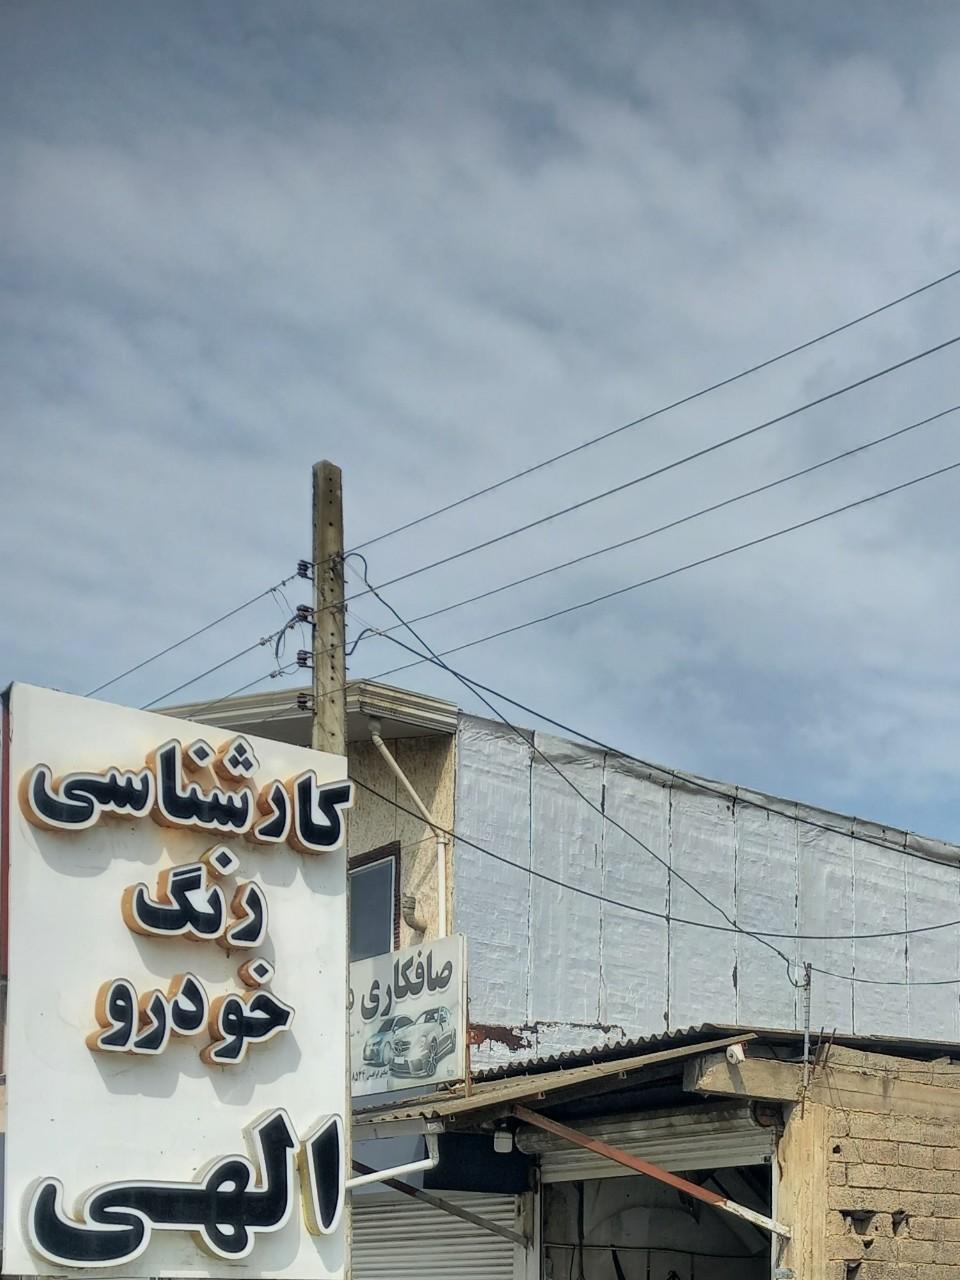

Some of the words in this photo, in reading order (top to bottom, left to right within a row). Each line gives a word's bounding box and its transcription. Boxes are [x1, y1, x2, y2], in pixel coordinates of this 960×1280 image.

[28, 738, 352, 852] کارشناسی
[132, 847, 268, 947] رنگ
[95, 957, 295, 1063] خودرو
[361, 949, 453, 1020] صافکاری
[30, 1106, 342, 1266] الهی
